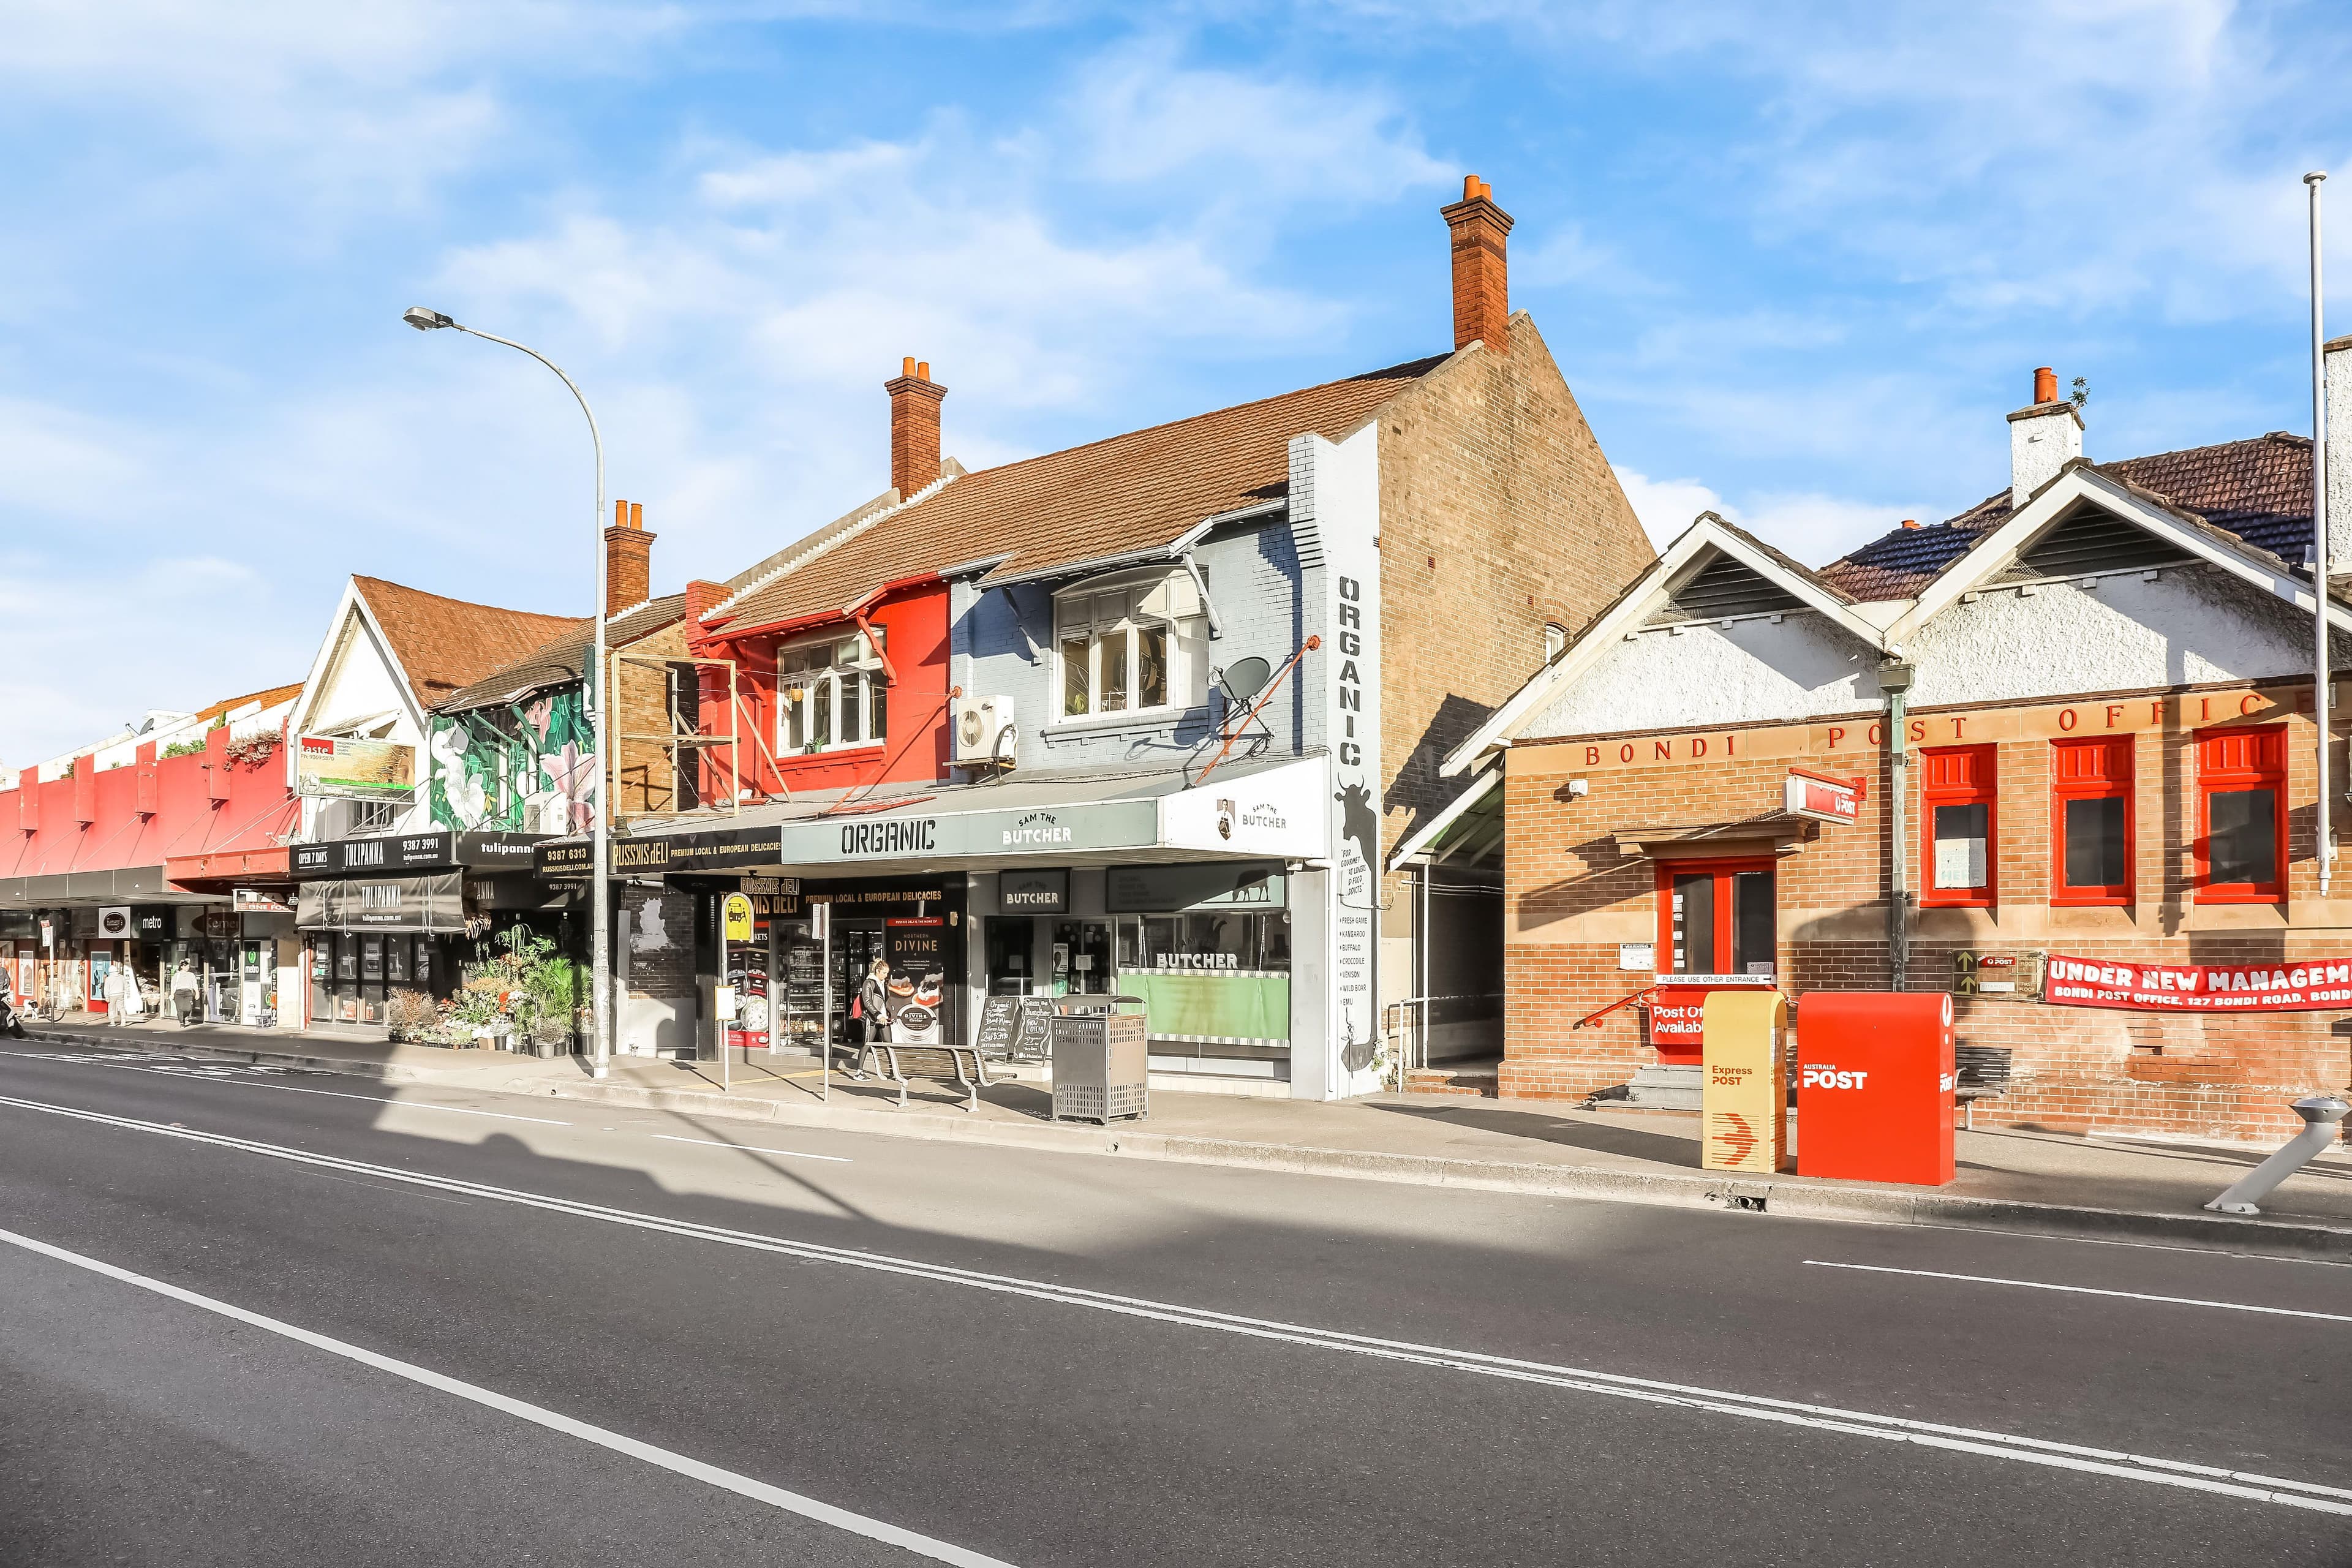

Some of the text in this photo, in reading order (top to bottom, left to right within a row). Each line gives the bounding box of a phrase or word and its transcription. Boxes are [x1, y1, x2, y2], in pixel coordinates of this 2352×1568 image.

[1339, 576, 1360, 766] ORGANIC
[1585, 691, 2315, 765] BONDI POST OFFICE
[301, 745, 329, 754] taste
[1253, 804, 1277, 815] SAM THE
[1841, 799, 1855, 815] POST
[1019, 813, 1057, 827] SAM THE
[1243, 815, 1286, 828] BUTCHER
[842, 820, 936, 854] ORGANIC
[1002, 827, 1072, 845] BUTCHER
[402, 838, 439, 851] 9387 3991
[671, 848, 694, 858] PREMIUM
[695, 846, 711, 856] LOCAL
[720, 844, 748, 854] EUROPEAN
[750, 842, 782, 852] DELICACIES
[298, 851, 328, 864] OPEN 7 DAYS
[345, 842, 383, 867] TULIPANNA
[548, 848, 586, 861] 9387 6313
[542, 862, 594, 873] RUSSKISDELI.COM.AU
[1341, 856, 1360, 867] GOURMET
[1354, 864, 1366, 874] LOVERS
[1352, 875, 1363, 884] FOOD
[361, 884, 401, 908] TULIPANNA
[805, 895, 834, 903] PREMIUM
[835, 894, 855, 903] LOCAL
[865, 892, 900, 902] EUROPEAN
[903, 891, 941, 900] DELICACIES
[1006, 892, 1058, 904] BUTCHER
[143, 916, 162, 929] metro
[895, 940, 937, 951] DIVINE
[1156, 953, 1238, 969] BUTCHER
[245, 965, 259, 973] metro
[2050, 960, 2352, 991] UNDER NEW MANAGEM
[2054, 986, 2094, 998] BONDI
[2097, 990, 2130, 1001] POST
[2133, 992, 2182, 1006] OFFICE,
[2214, 997, 2258, 1006] BONDI
[2262, 992, 2306, 1005] ROAD,
[2310, 989, 2352, 1001] BOND
[1653, 1006, 1685, 1018] Post
[1712, 1065, 1752, 1076] Express
[1712, 1076, 1742, 1085] POST
[1803, 1070, 1868, 1090] POST
[1940, 1076, 1953, 1093] POST
